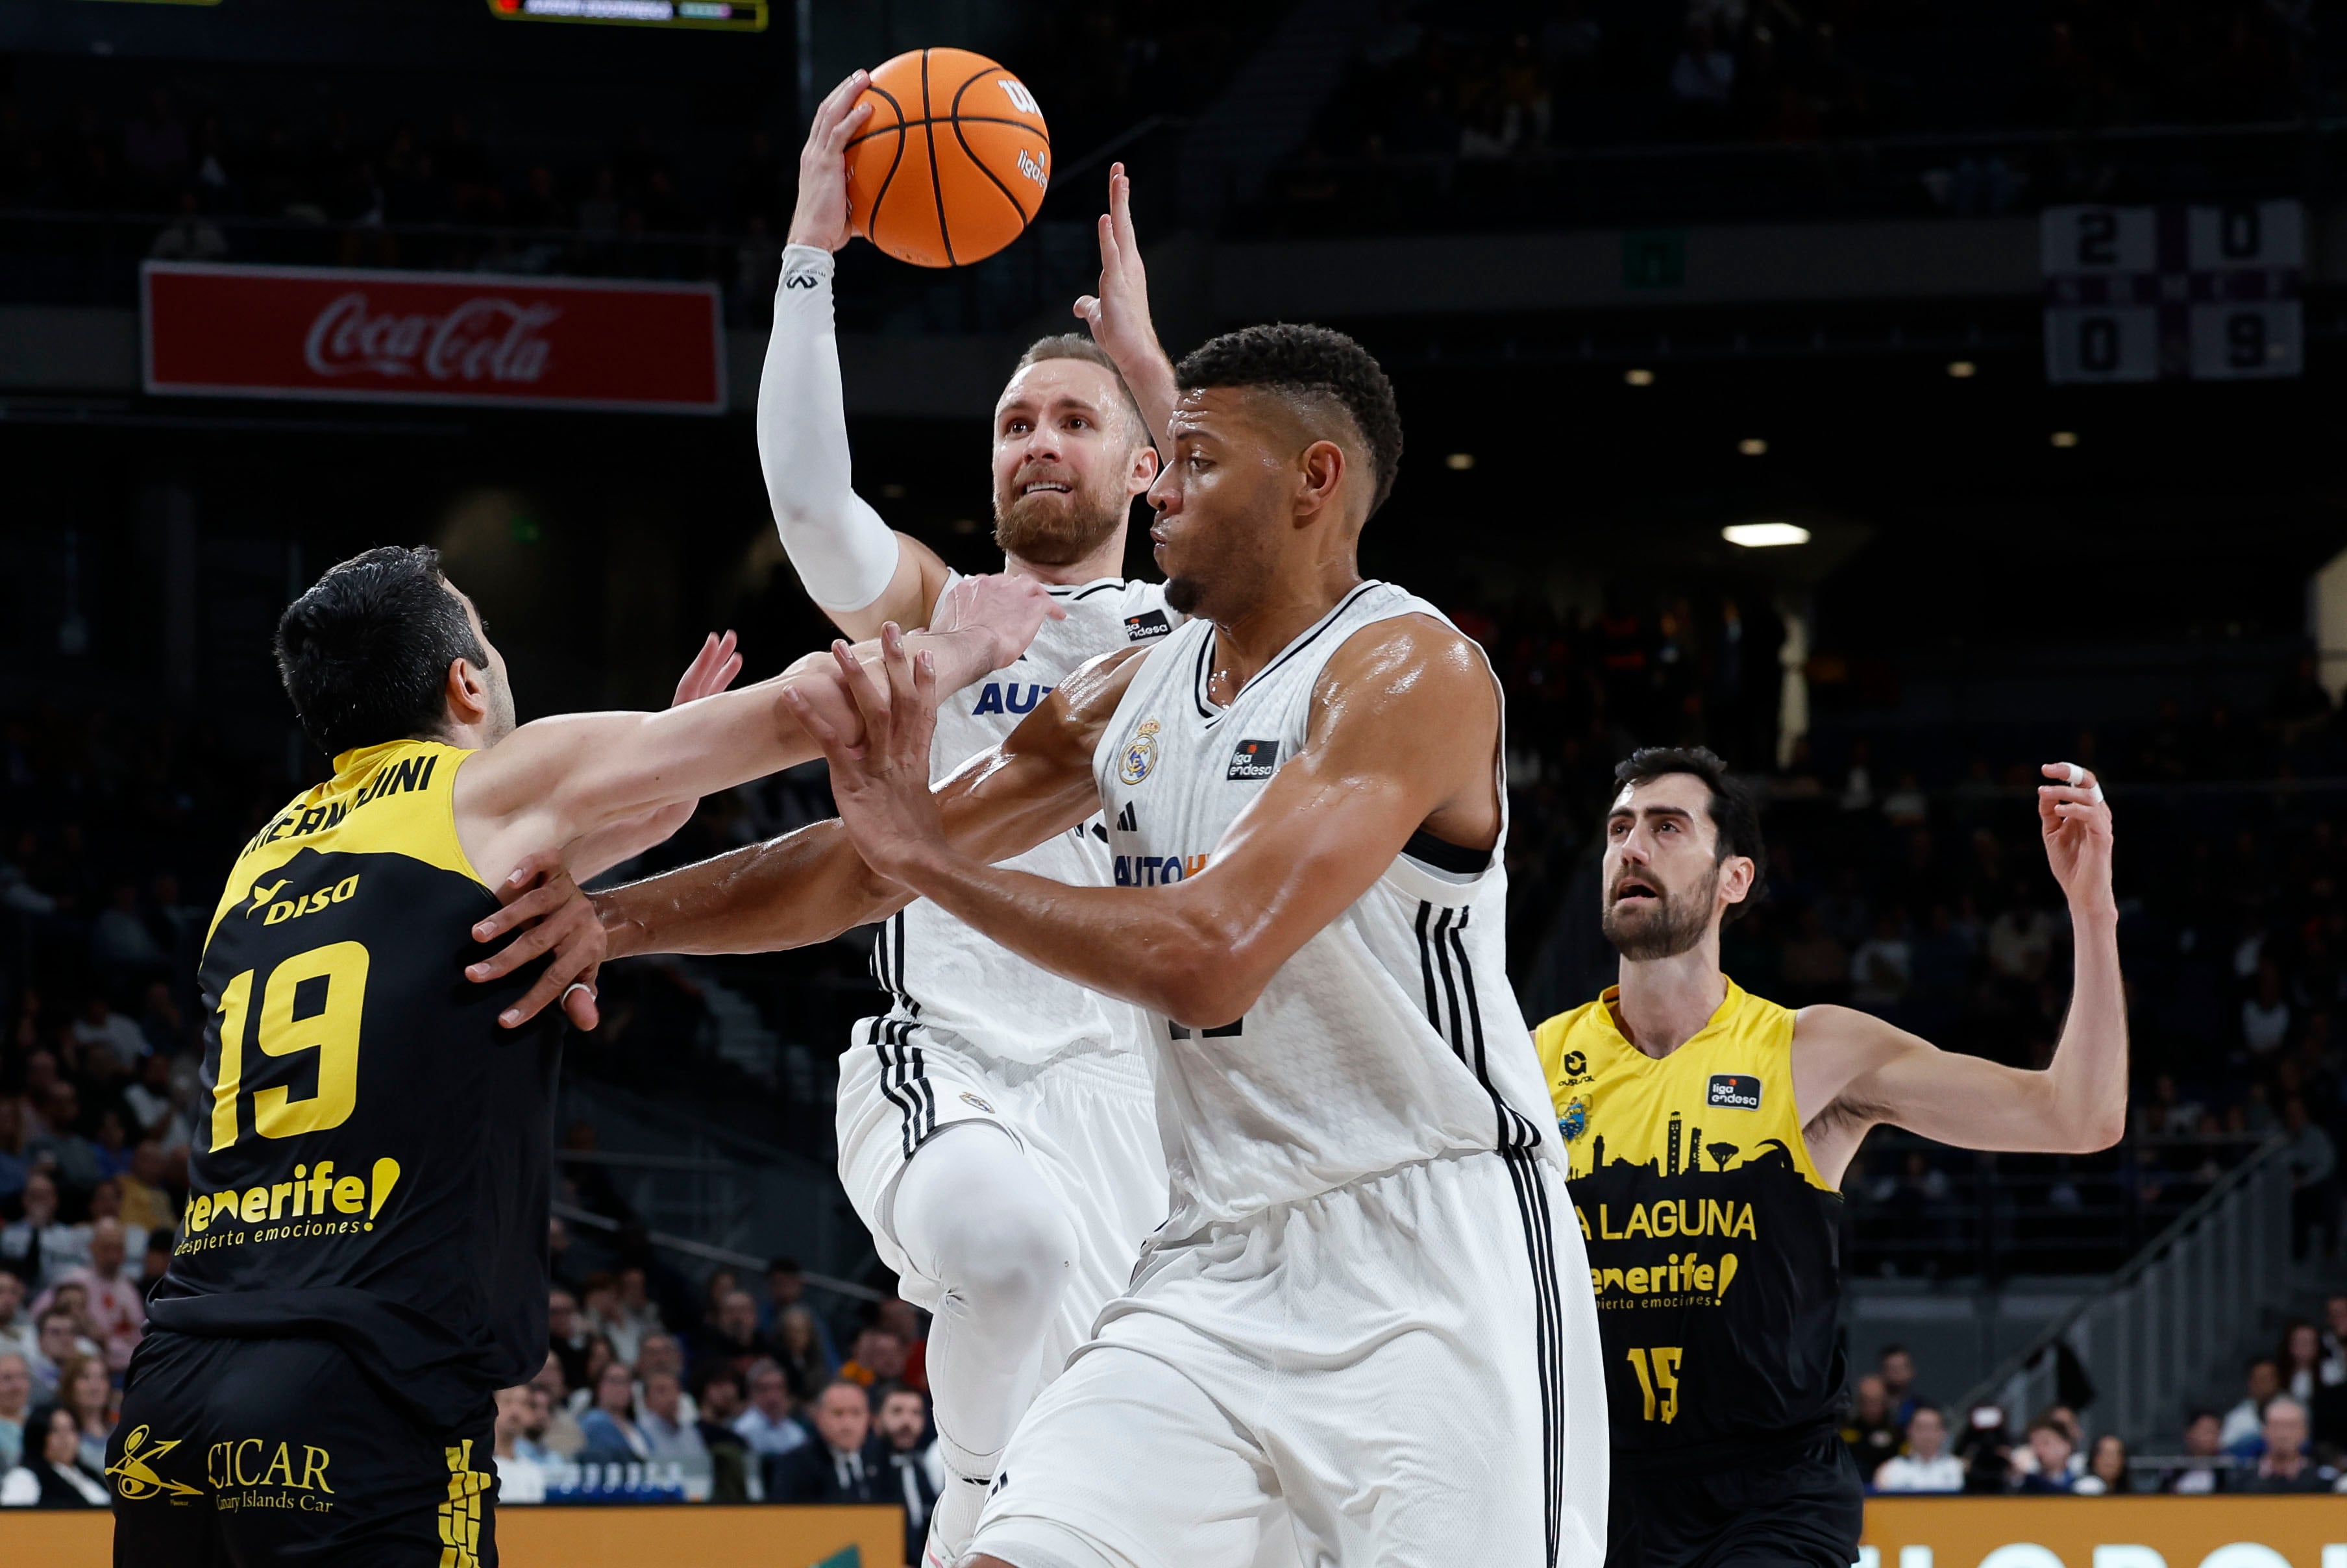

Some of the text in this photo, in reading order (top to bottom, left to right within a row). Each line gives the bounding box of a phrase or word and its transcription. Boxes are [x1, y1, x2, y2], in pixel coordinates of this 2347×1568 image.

[1229, 764, 1272, 776] endesa
[208, 940, 370, 1154] 19
[1712, 1083, 1734, 1095] liga
[1712, 1094, 1757, 1105] endesa
[1600, 1199, 1756, 1240] LAGUNA
[1627, 1347, 1683, 1424] 15
[208, 1439, 335, 1493] CICAR
[242, 1490, 294, 1509] Islands
[300, 1495, 333, 1512] Car
